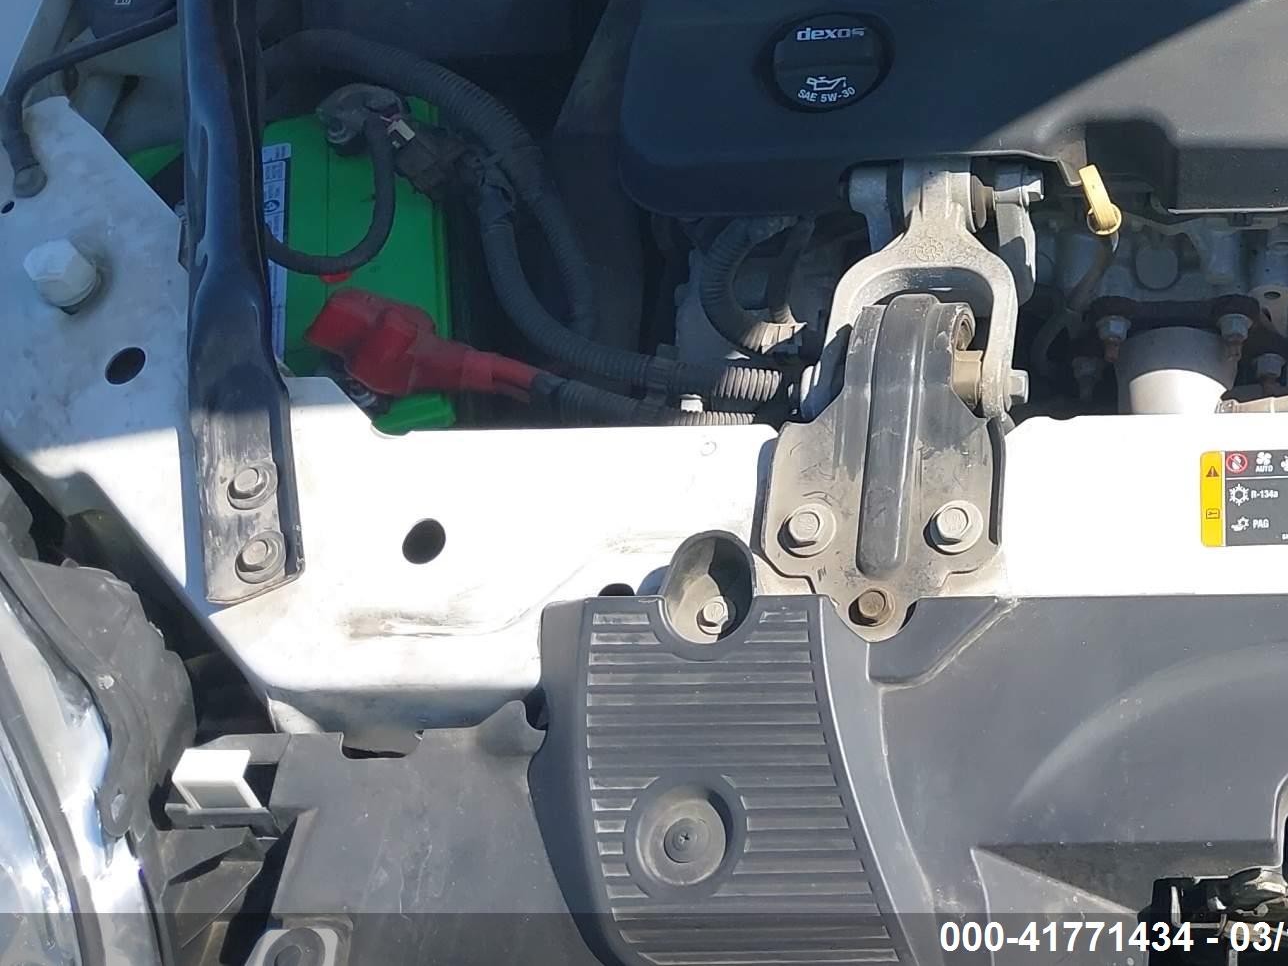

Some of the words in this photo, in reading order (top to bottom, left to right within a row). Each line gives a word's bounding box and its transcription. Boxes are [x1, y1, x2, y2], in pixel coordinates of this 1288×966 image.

[796, 27, 866, 41] dexos
[798, 89, 818, 102] SAE
[820, 87, 855, 102] 5W-30
[1255, 464, 1273, 472] AUTO
[1250, 489, 1278, 498] R-134a
[1252, 518, 1270, 529] PAG
